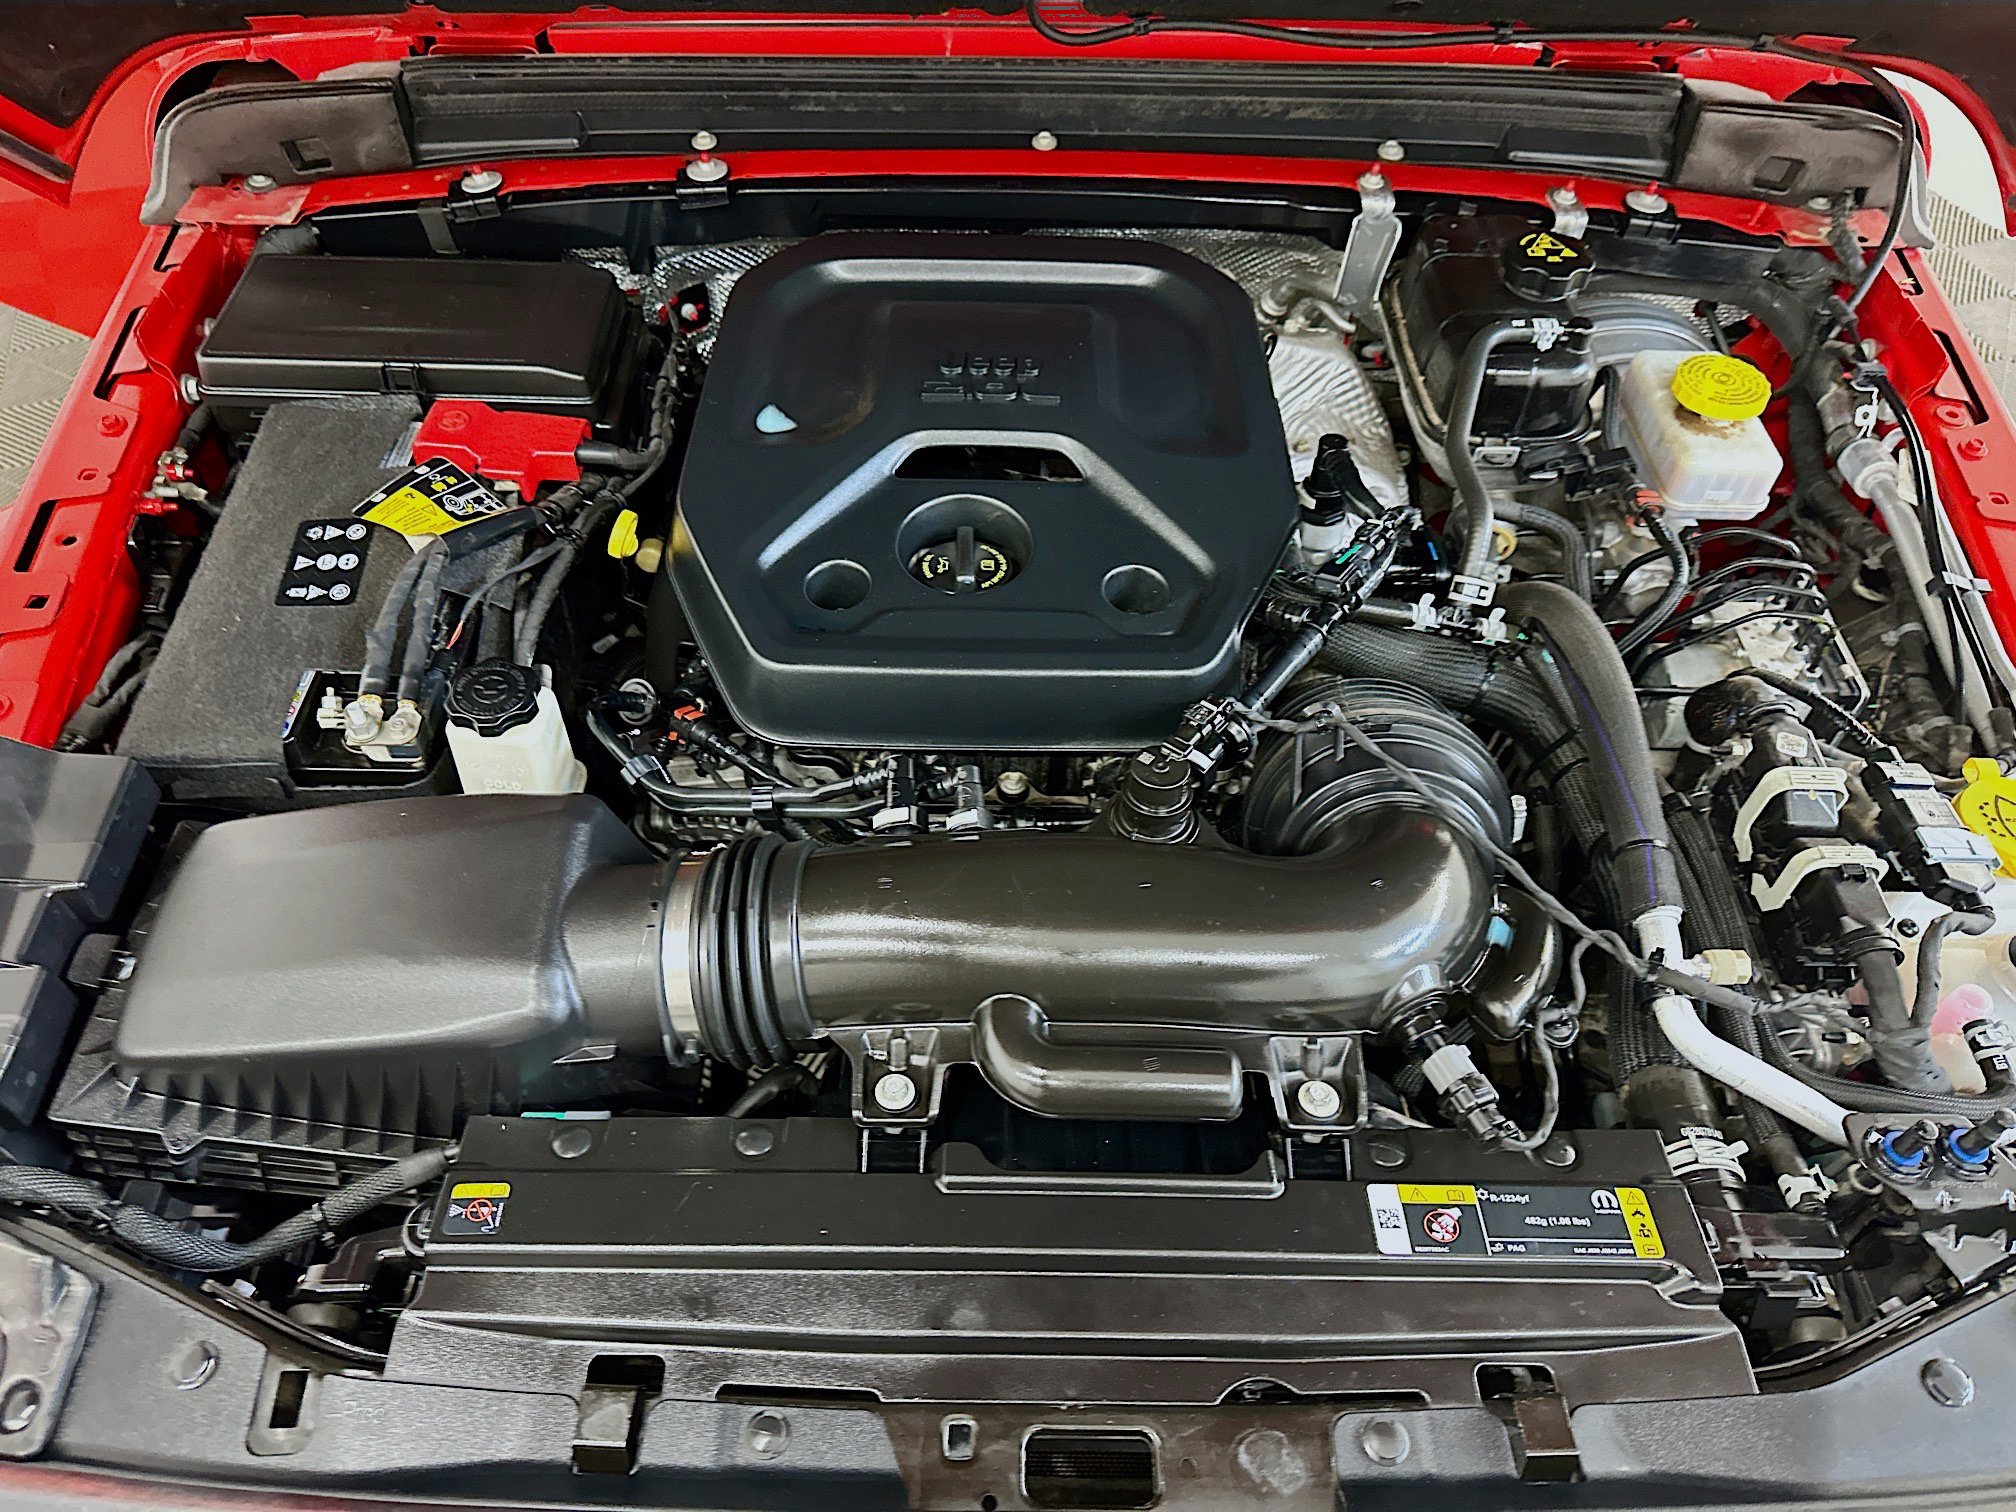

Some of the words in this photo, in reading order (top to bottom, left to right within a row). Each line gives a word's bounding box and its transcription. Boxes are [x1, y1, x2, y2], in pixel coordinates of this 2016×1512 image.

[939, 351, 1040, 382] Jeep
[1489, 1193, 1530, 1205] R-1234yf
[1572, 1216, 1591, 1228] lbs)
